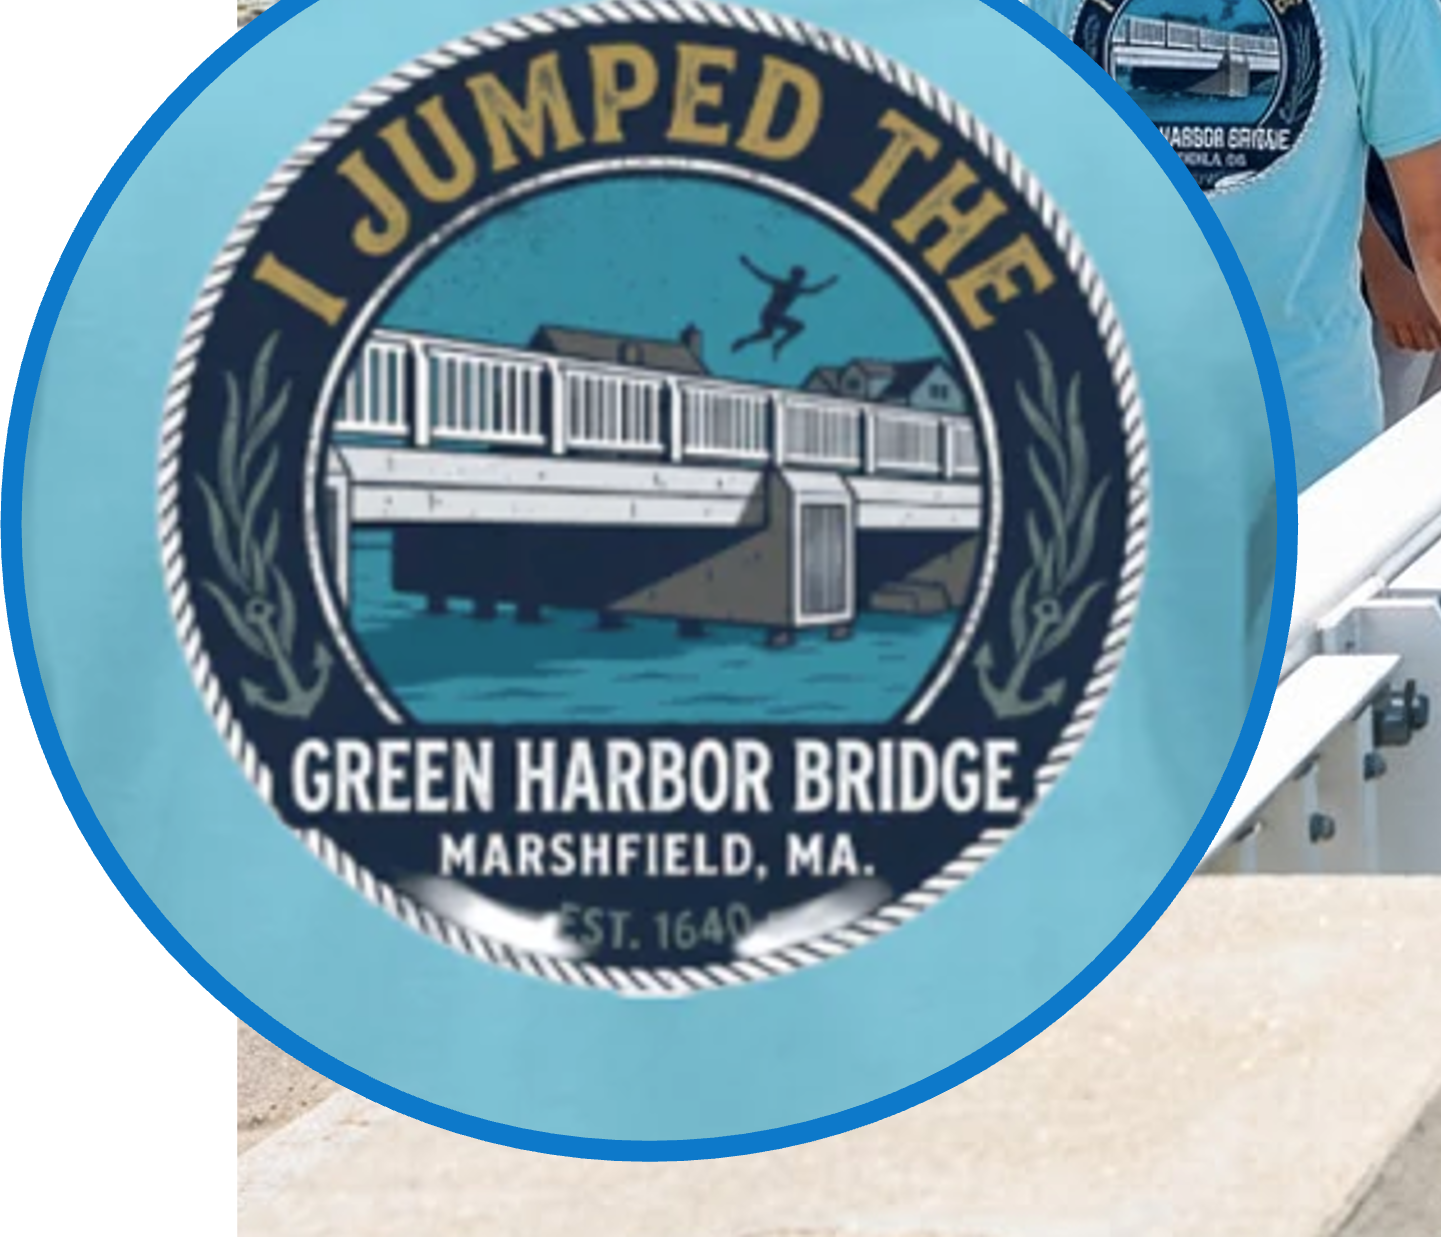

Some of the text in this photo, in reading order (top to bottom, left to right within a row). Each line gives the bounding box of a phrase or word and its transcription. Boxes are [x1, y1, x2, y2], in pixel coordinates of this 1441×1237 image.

[253, 41, 1056, 330] I JUMPED THE
[291, 738, 1021, 814] GREEN HARBOR BRIDGE
[439, 831, 876, 881] MARSHFIELD, MA.
[559, 902, 754, 952] EST. 1640
